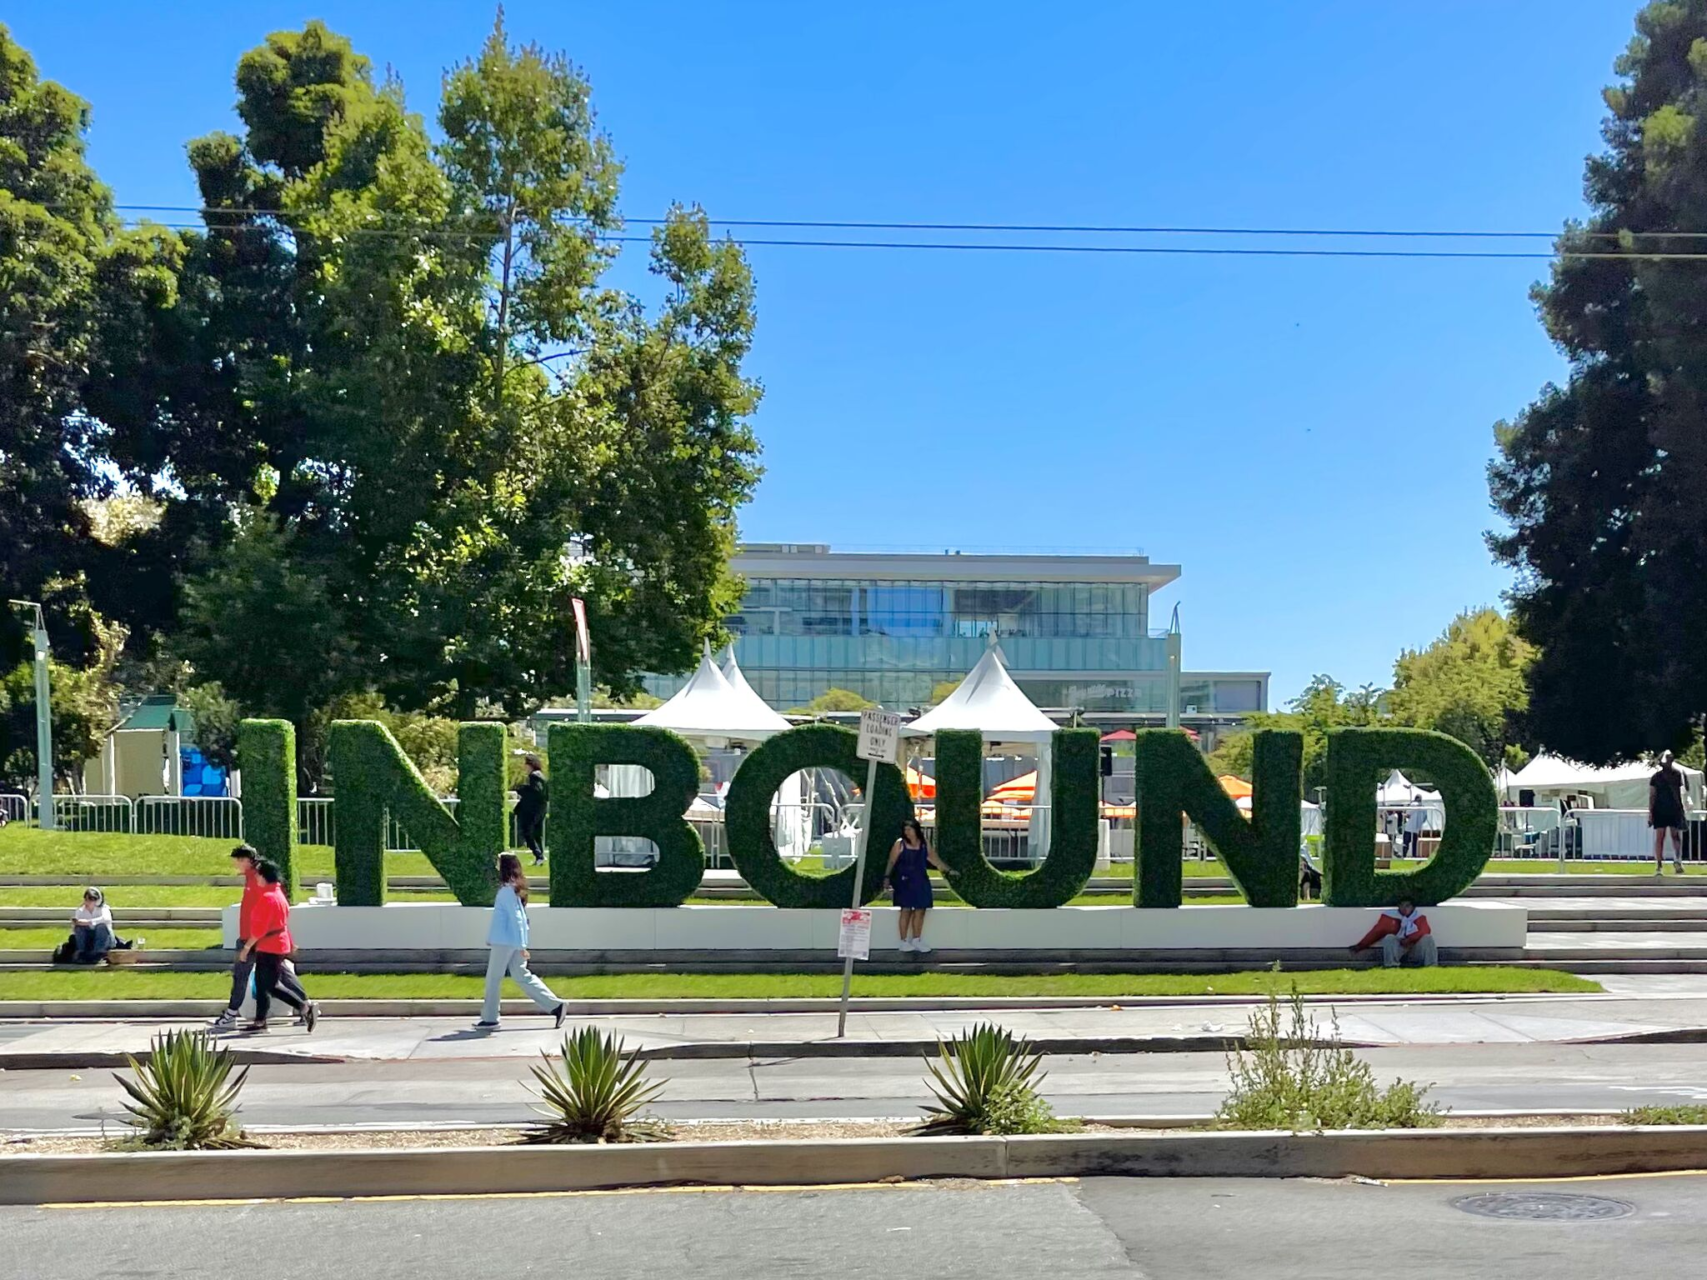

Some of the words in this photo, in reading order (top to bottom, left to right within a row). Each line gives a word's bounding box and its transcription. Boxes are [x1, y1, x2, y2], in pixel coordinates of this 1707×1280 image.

[862, 711, 898, 725] PASSENGER
[866, 723, 893, 737] LOADING
[870, 736, 886, 747] ONLY
[238, 718, 1499, 909] INBOUND
